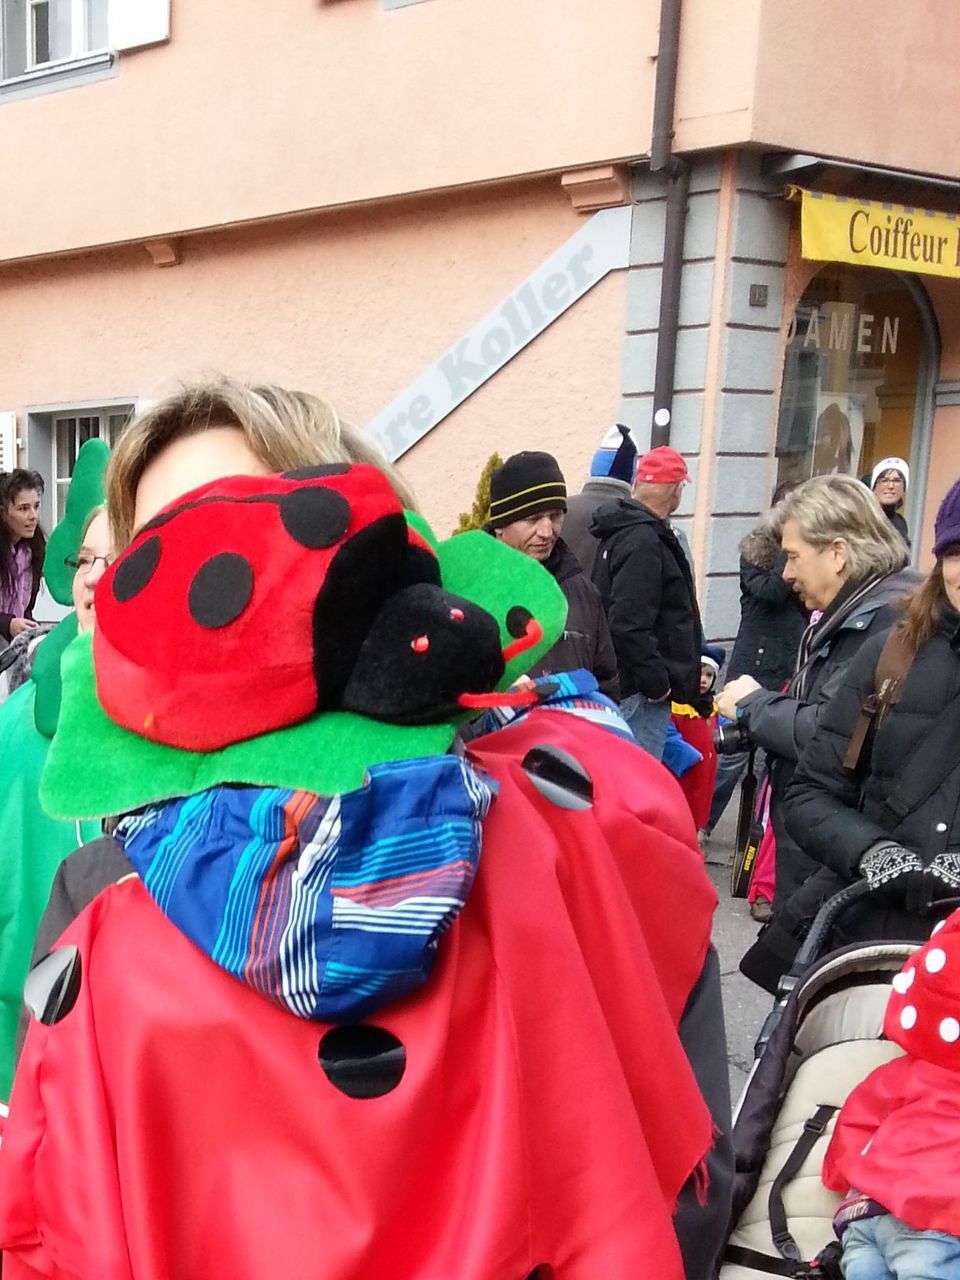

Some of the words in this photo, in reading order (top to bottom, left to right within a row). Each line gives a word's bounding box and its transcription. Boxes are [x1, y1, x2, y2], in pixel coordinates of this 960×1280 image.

[849, 210, 948, 265] Coiffeur
[376, 394, 435, 455] re
[437, 243, 594, 399] Koller
